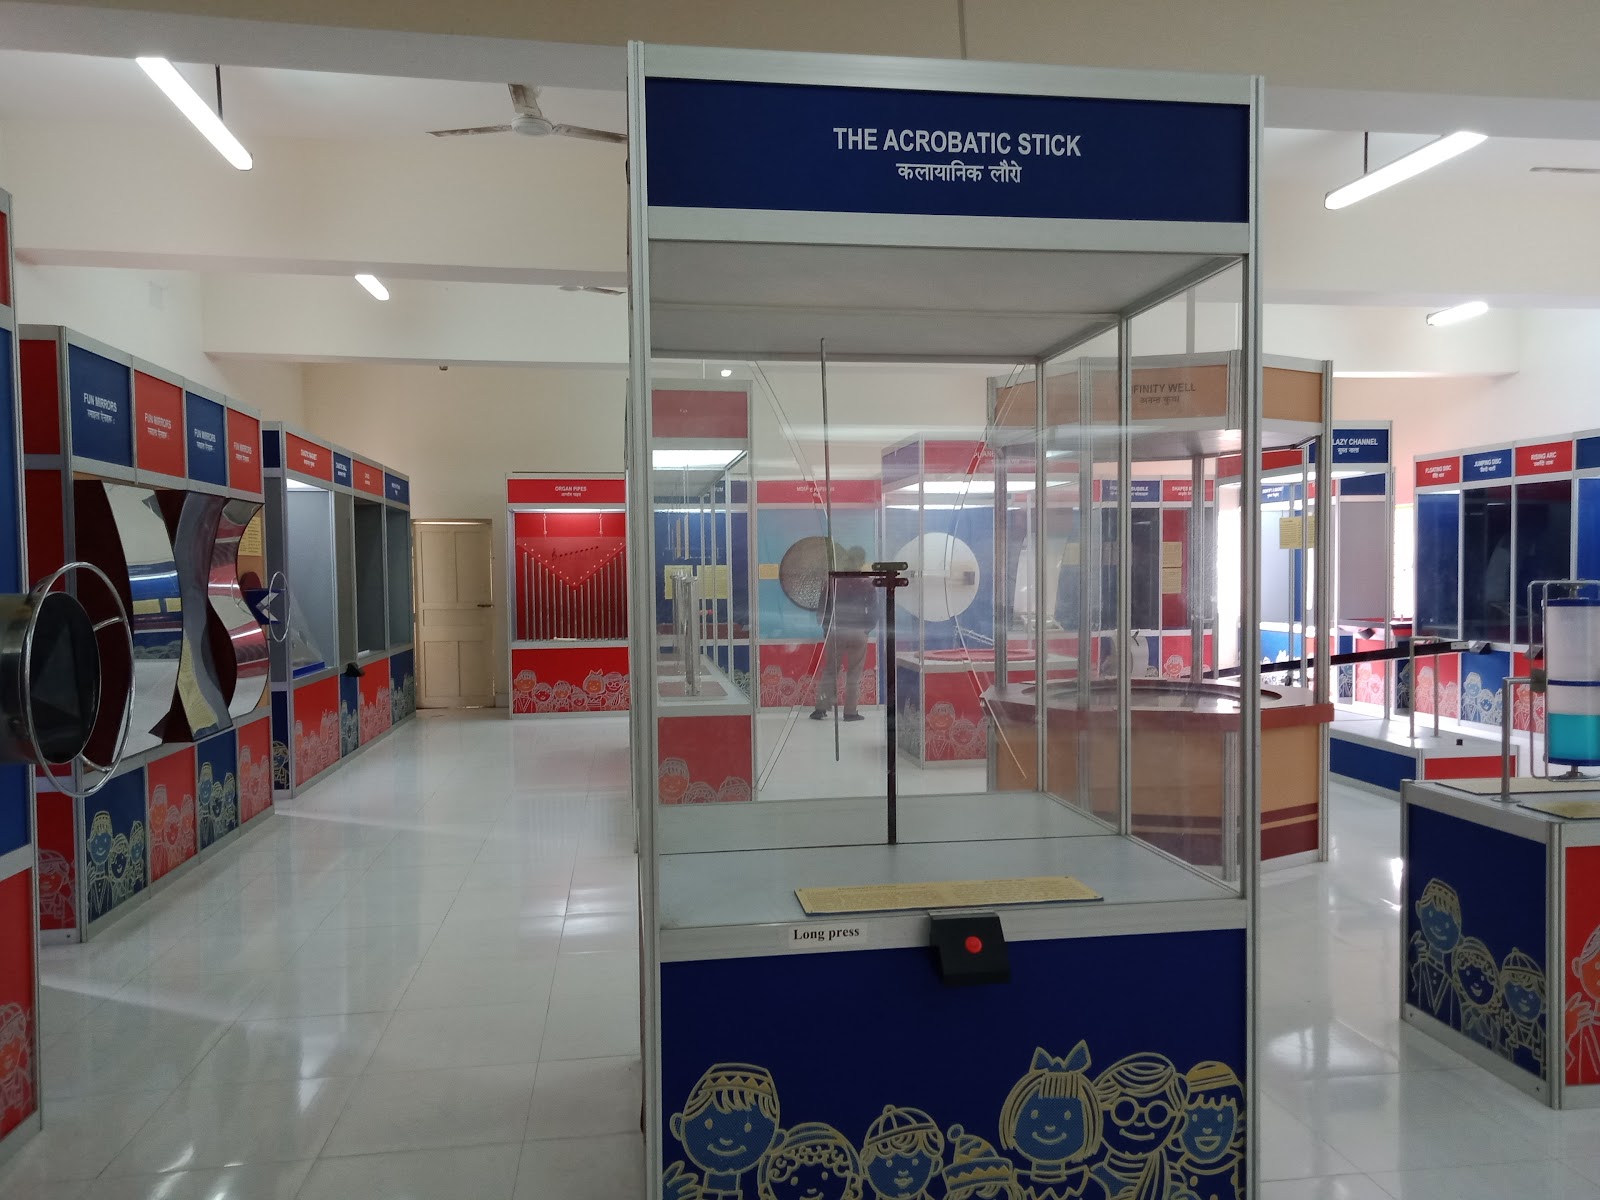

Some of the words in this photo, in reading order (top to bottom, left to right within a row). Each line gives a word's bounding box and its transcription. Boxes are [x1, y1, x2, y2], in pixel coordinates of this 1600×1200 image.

[833, 128, 878, 151] THE
[883, 129, 1012, 154] ACROBATIC
[1018, 133, 1082, 156] STICK
[896, 159, 984, 182] कलायानिक
[1131, 384, 1166, 394] FINITY
[1169, 383, 1197, 393] WELL
[84, 392, 95, 405] FUN
[95, 396, 117, 412] MIRRORS
[145, 412, 154, 424] FUN
[154, 415, 171, 429] MIRRORS
[1332, 438, 1348, 446] LAZY
[1348, 438, 1378, 446] CHANNEL
[1530, 453, 1546, 461] RISING
[794, 929, 825, 941] Long
[829, 928, 860, 941] press
